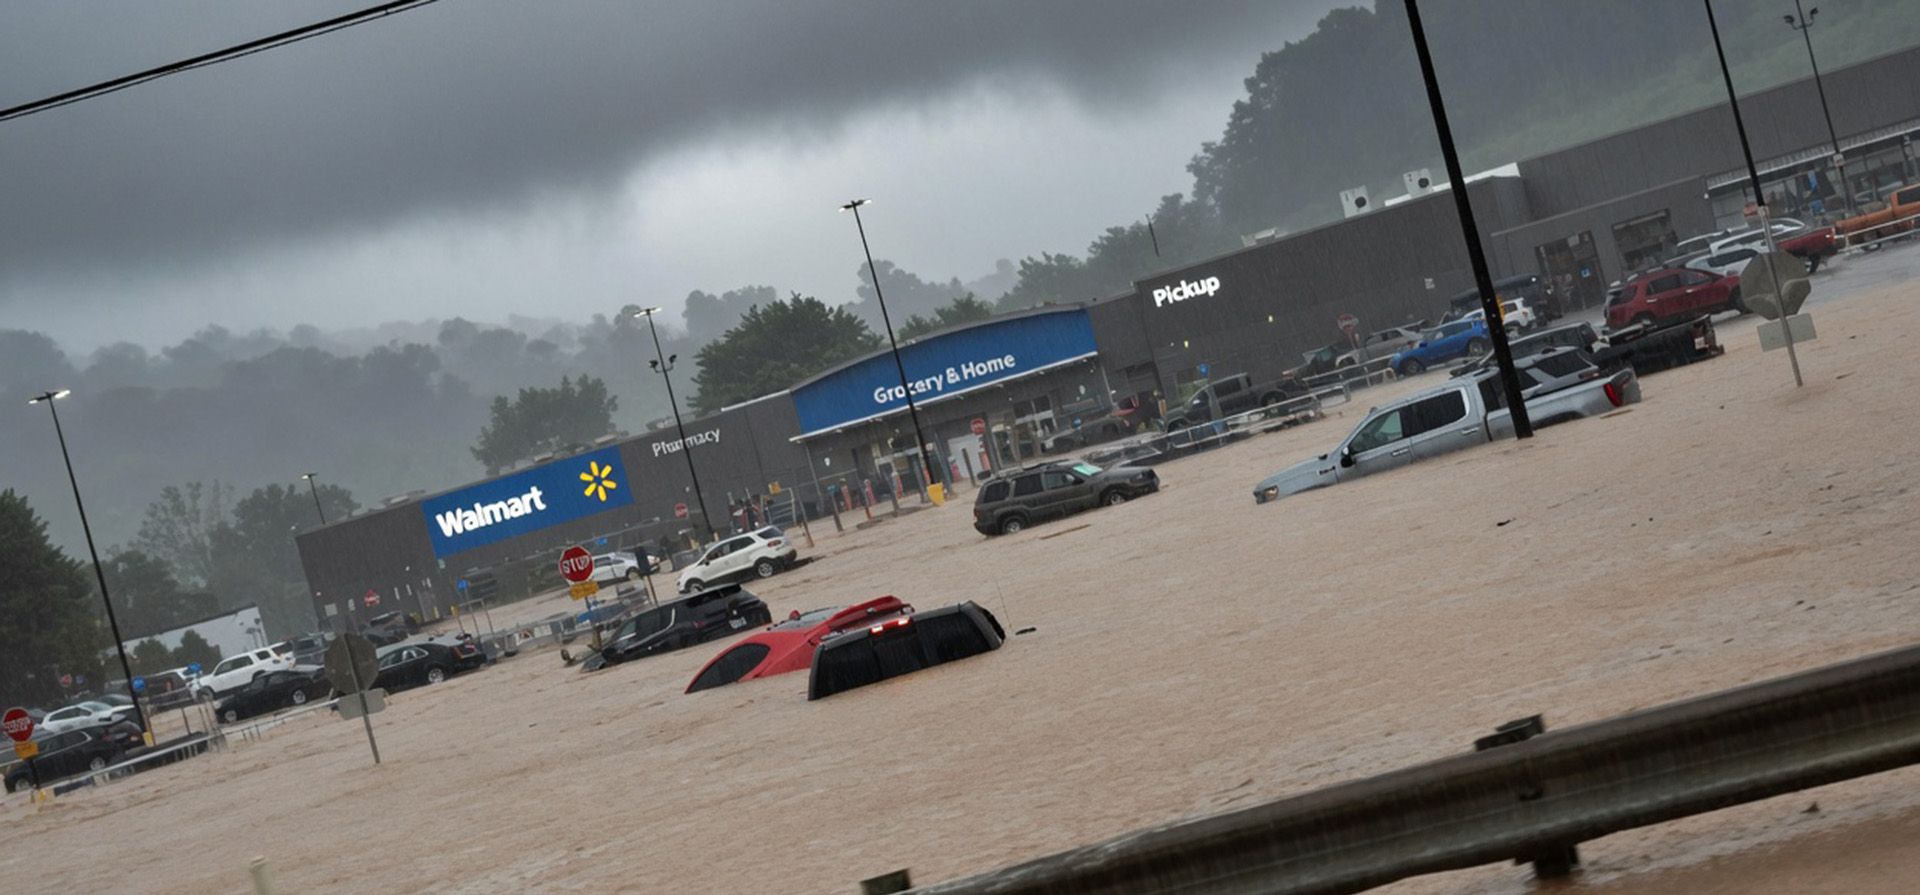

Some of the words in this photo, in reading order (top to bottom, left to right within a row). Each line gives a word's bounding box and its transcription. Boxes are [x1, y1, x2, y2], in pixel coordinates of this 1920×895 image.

[1152, 276, 1220, 308] Pickup
[873, 373, 943, 404] Grocery
[945, 367, 961, 384] &
[961, 354, 1016, 380] Home
[435, 486, 547, 537] Walmart
